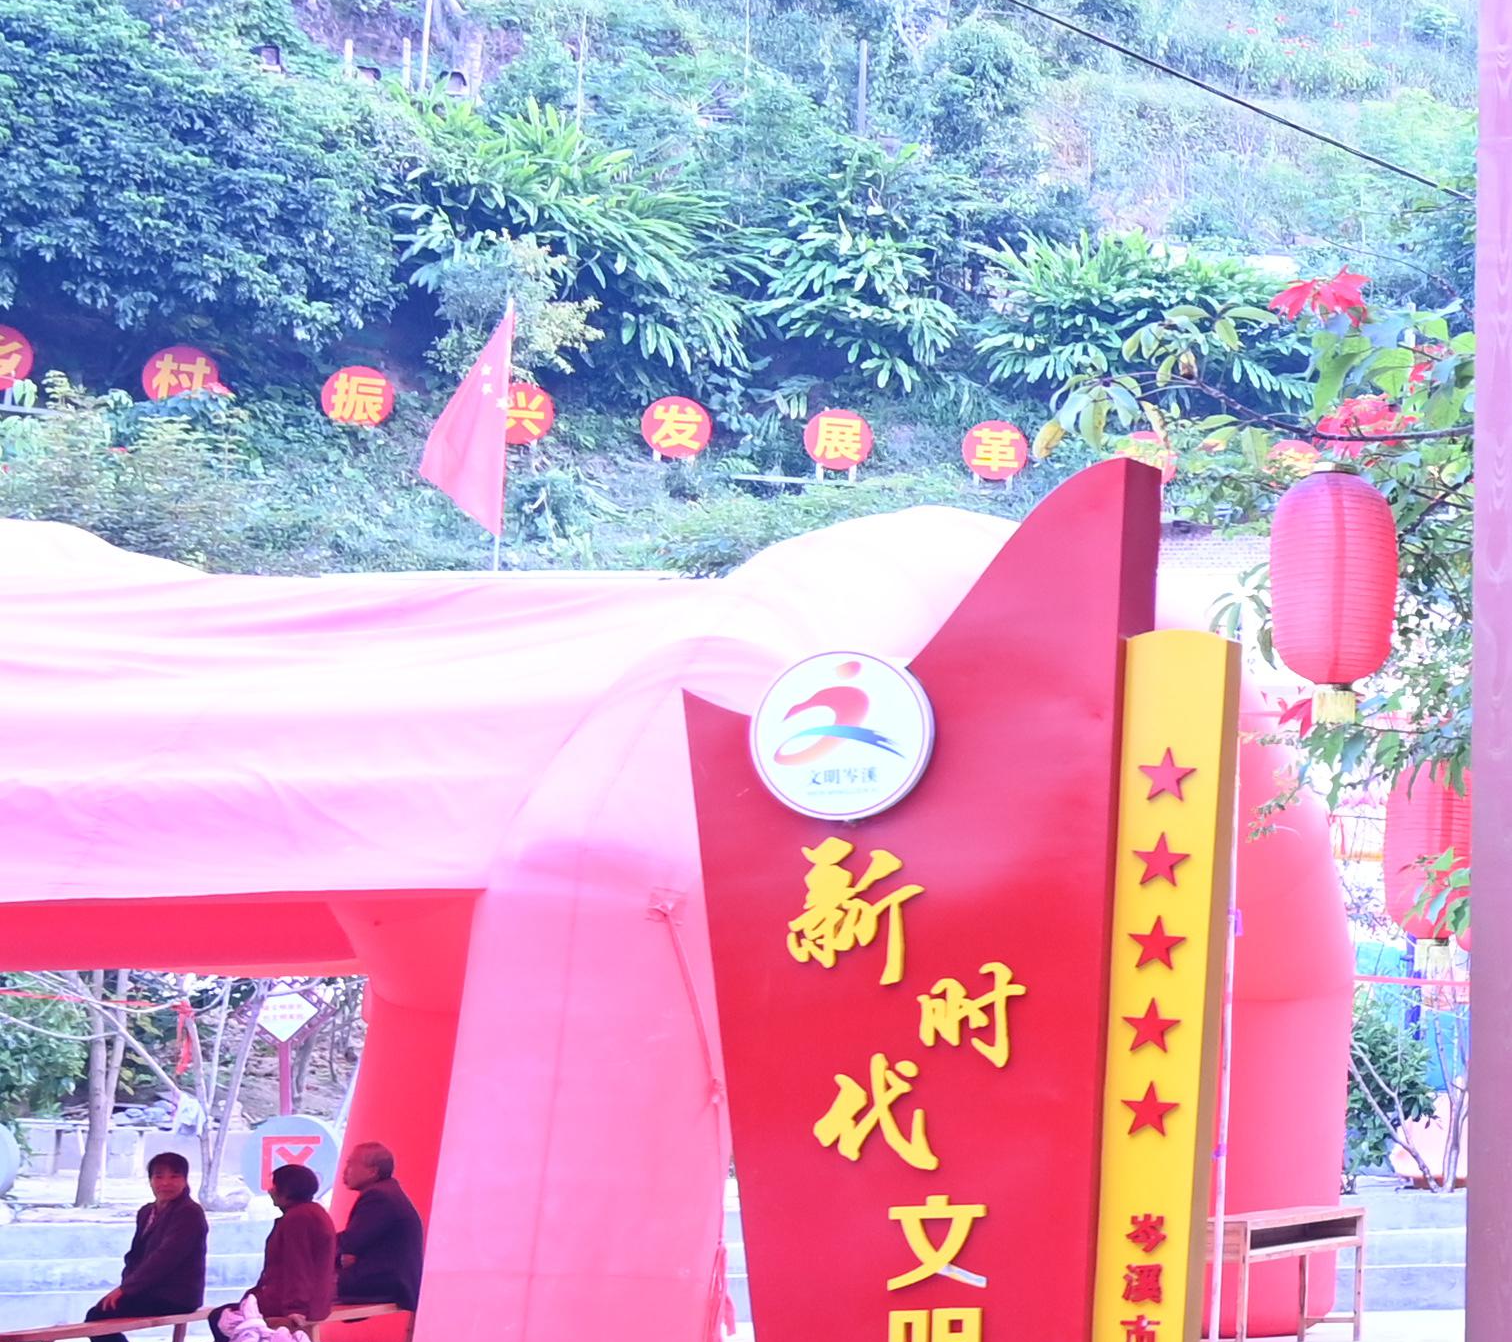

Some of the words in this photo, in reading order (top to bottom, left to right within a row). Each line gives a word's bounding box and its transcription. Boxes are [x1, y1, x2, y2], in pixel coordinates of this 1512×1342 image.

[152, 353, 211, 399] 村
[331, 374, 385, 423] 振
[650, 404, 704, 450] 发
[813, 419, 862, 461] 展
[975, 425, 1021, 472] 革
[785, 836, 1026, 1173] 新时代
